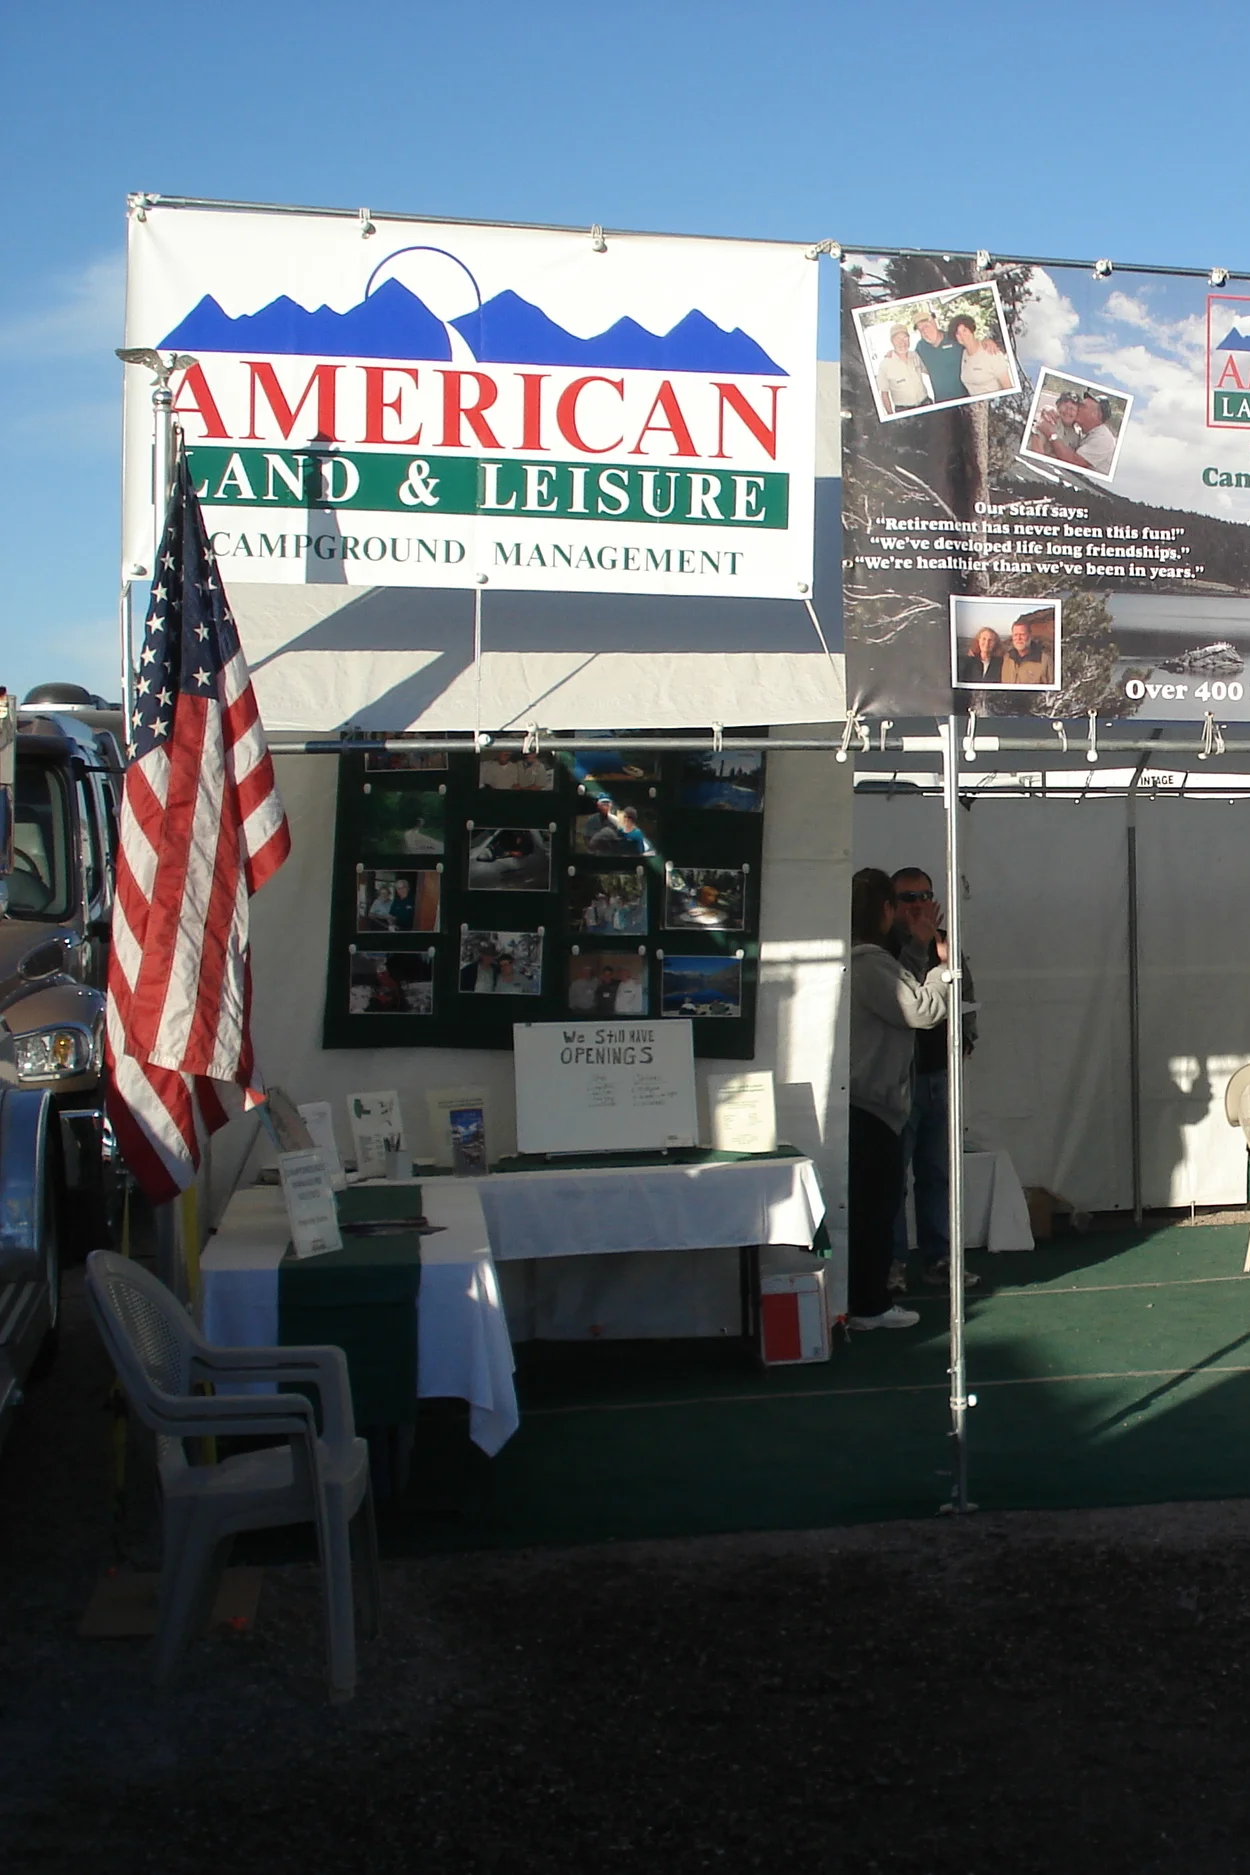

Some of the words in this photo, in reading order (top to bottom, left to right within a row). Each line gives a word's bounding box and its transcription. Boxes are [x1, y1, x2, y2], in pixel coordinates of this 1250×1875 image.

[172, 361, 787, 460] AMERICAN
[399, 459, 440, 506] &
[480, 463, 766, 522] LEISURE
[974, 501, 1004, 515] Our
[1009, 503, 1049, 518] Staff
[1050, 507, 1089, 521] says:
[981, 520, 1010, 534] has
[1014, 523, 1061, 537] never
[1063, 523, 1103, 538] been
[1106, 525, 1138, 540] this
[210, 532, 466, 563] CAMPGROUND
[493, 541, 744, 576] MANAGEMENT
[933, 537, 1016, 556] developed
[1016, 540, 1043, 554] life
[1046, 541, 1083, 559] long
[916, 556, 989, 572] healthier
[993, 558, 1032, 573] than
[1036, 561, 1082, 576] we've
[1086, 561, 1125, 576] been
[1129, 562, 1146, 577] in
[1125, 680, 1188, 701] Over
[1194, 681, 1244, 701] 400
[1140, 775, 1174, 786] INTAGE
[563, 1030, 585, 1044] We
[629, 1029, 655, 1043] HAVE
[560, 1046, 654, 1065] OPENINGS
